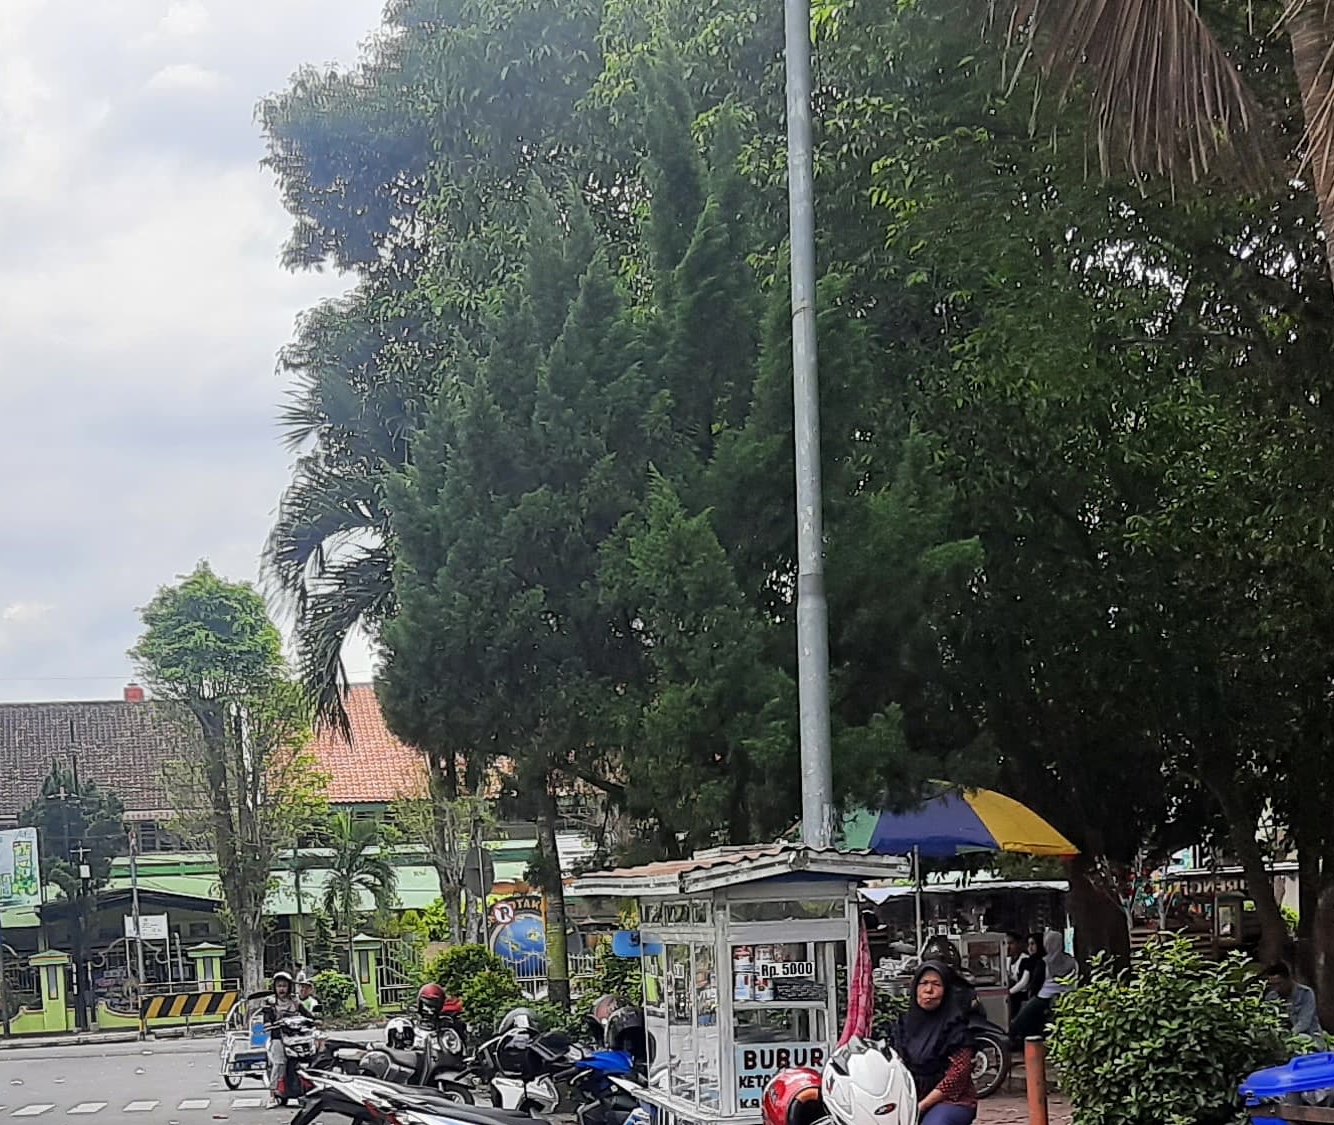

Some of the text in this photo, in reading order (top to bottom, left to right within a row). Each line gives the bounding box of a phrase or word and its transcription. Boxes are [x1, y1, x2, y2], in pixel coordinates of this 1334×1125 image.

[761, 962, 813, 978] Rp. 5000
[744, 1047, 823, 1070] BUBUR
[739, 1075, 774, 1089] KETA
